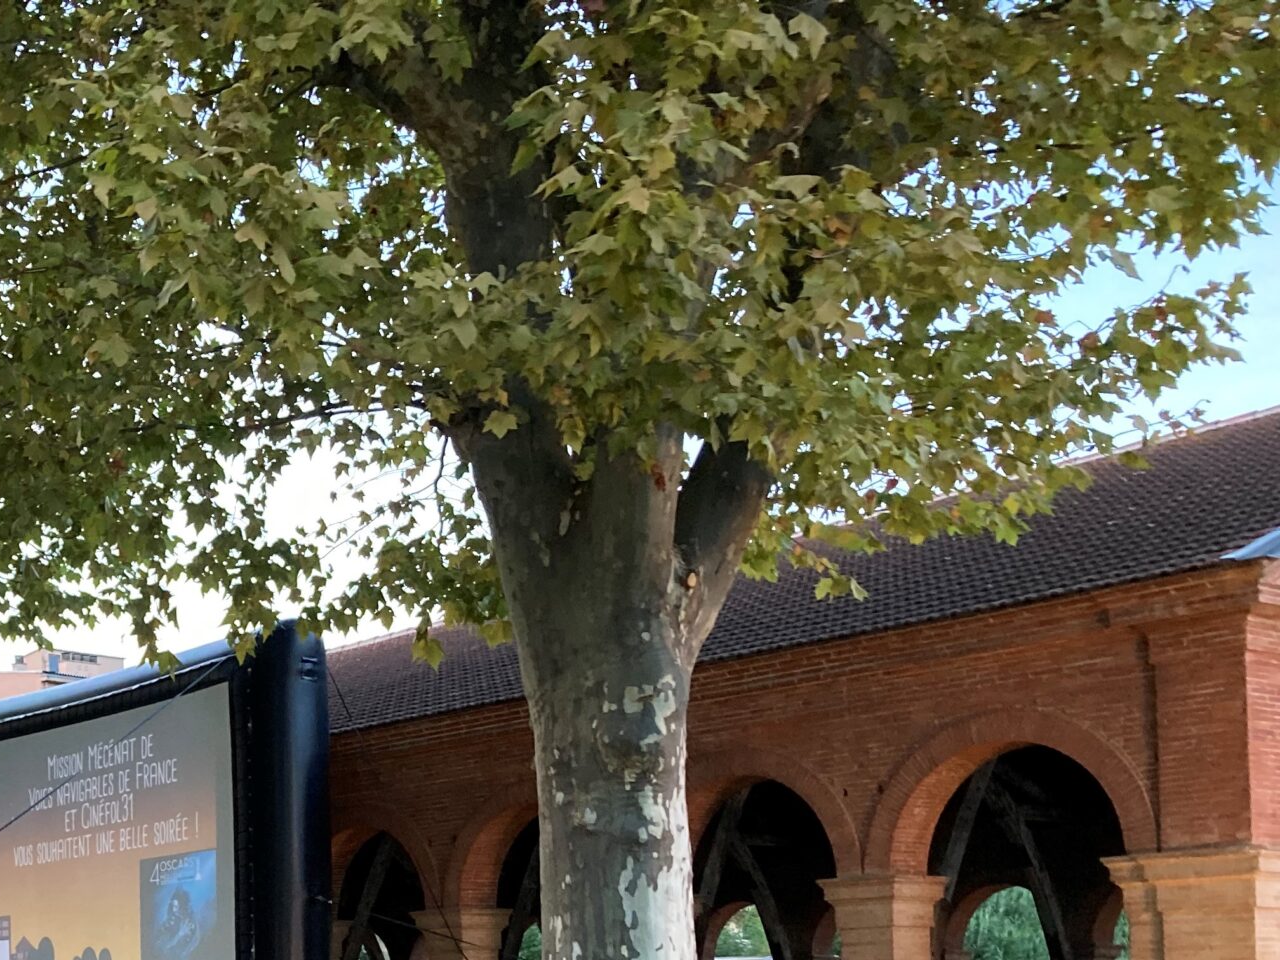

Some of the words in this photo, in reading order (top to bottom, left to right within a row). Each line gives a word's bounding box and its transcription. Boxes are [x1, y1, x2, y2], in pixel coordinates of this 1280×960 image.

[47, 751, 84, 782] MISSION
[88, 737, 136, 771] MÉCÉNAT
[141, 734, 154, 758] DE
[57, 772, 114, 805] NAVIGABLES
[118, 769, 131, 794] DE
[136, 758, 178, 790] FRANCE
[13, 844, 33, 867] VOUS
[36, 834, 91, 864] SOUHAITENT
[96, 831, 115, 854] UNE
[120, 824, 148, 851] BELLE
[153, 812, 188, 845] SOIRÉE
[64, 807, 77, 833] ET
[149, 862, 160, 886] 4
